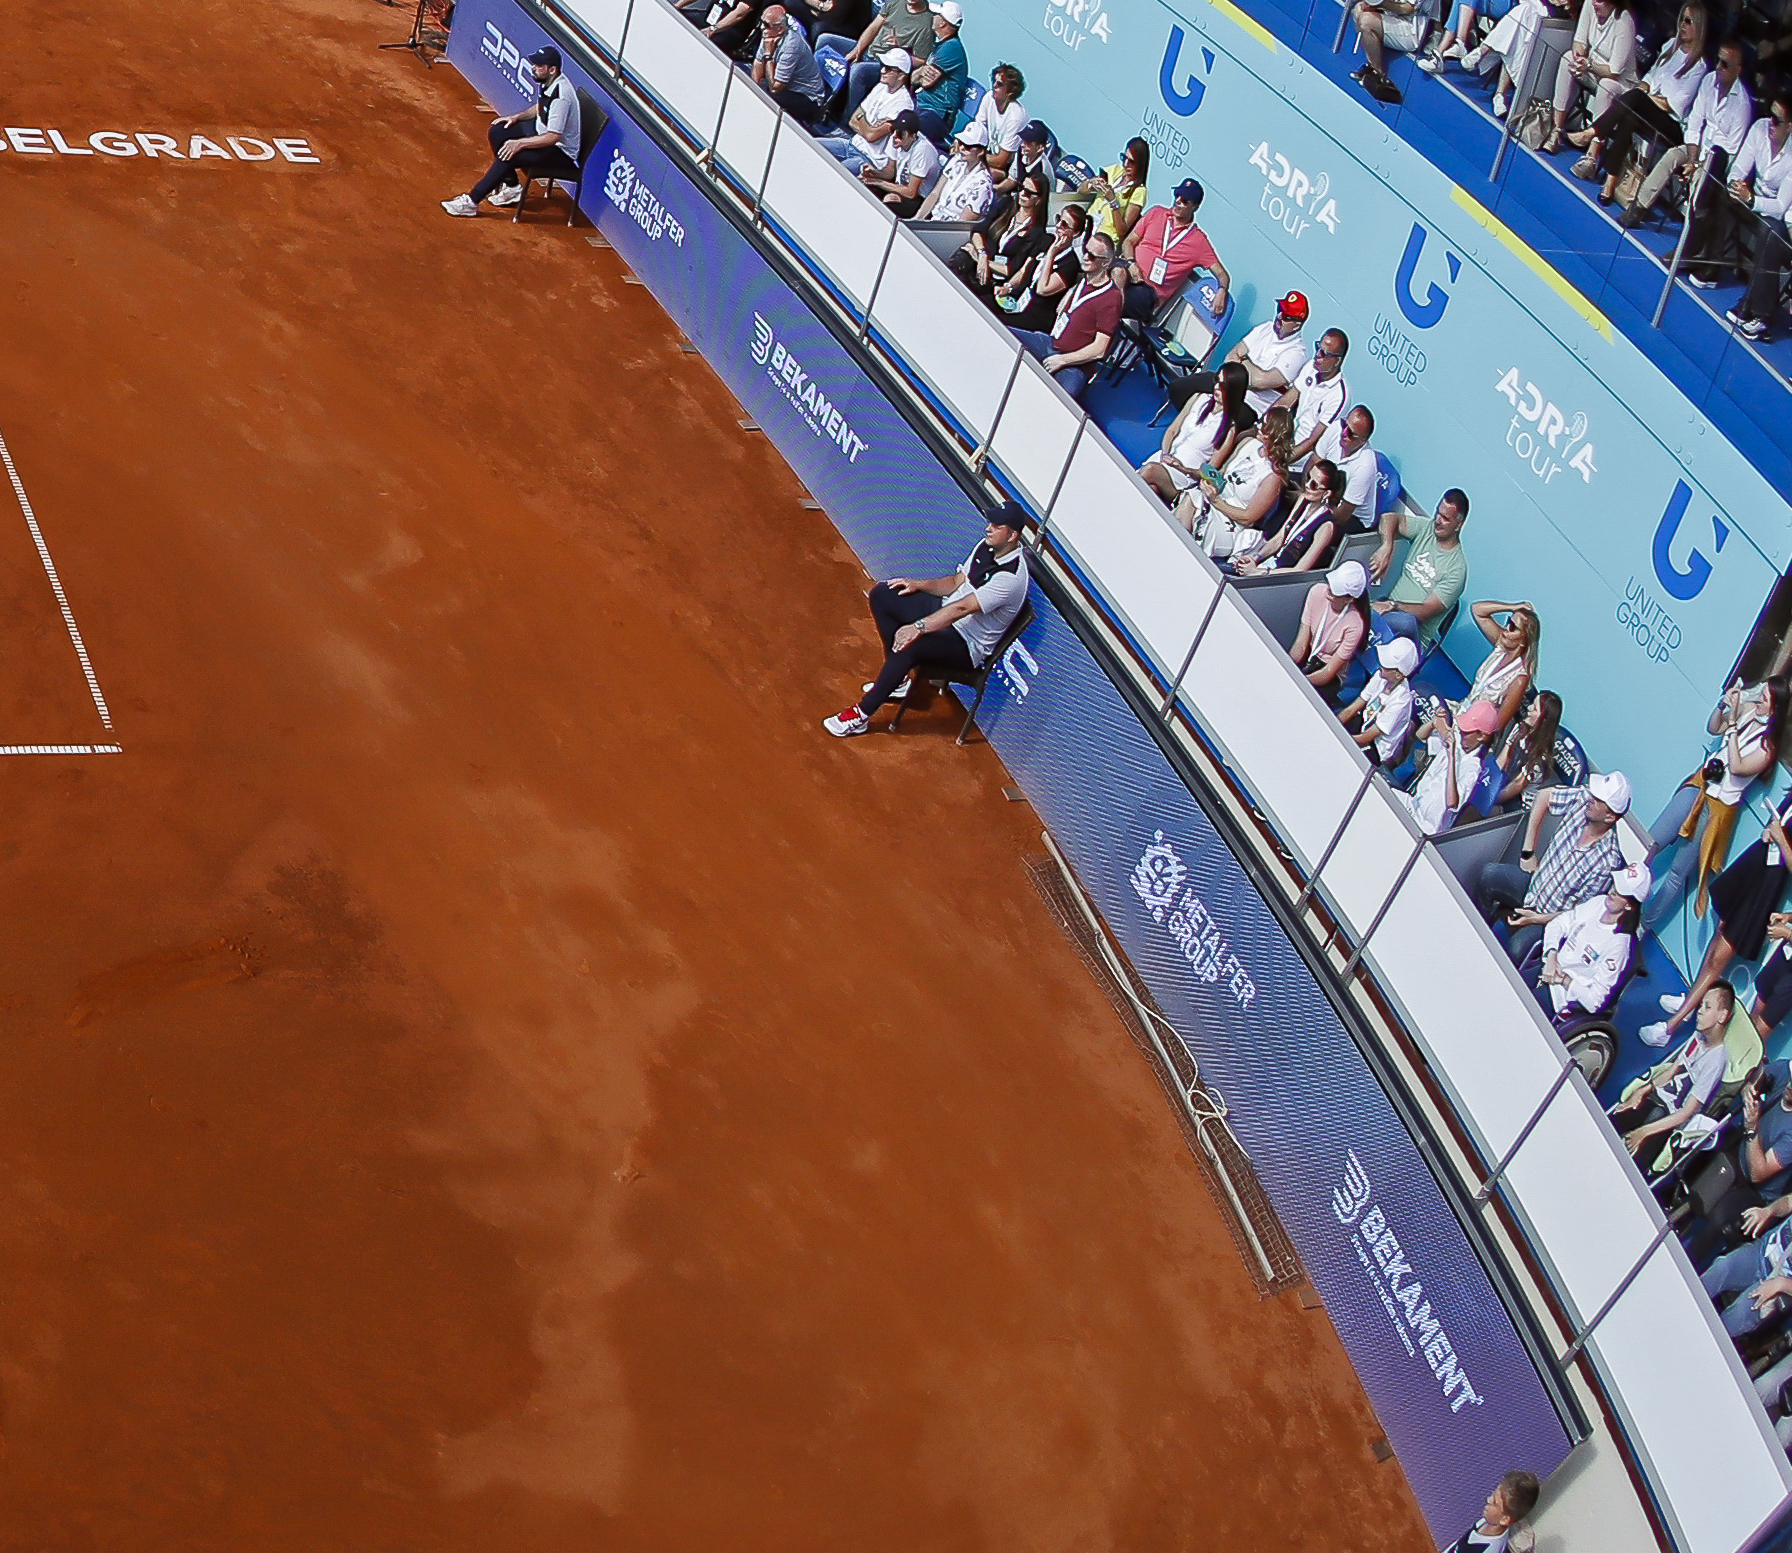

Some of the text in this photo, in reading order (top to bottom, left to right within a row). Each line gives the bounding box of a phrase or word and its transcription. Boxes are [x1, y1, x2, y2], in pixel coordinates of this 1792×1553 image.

[1043, 1, 1088, 52] tour
[1138, 126, 1183, 172] GROUP
[1142, 104, 1191, 157] UNITED
[628, 199, 663, 241] GROUP
[632, 178, 687, 248] METALFER
[1247, 140, 1342, 236] ADRIA
[1259, 182, 1311, 240] tour
[1366, 333, 1419, 390] GROUP
[1372, 311, 1428, 375] UNITED
[770, 340, 869, 464] BEKAMENT
[1493, 366, 1599, 485] ADRIA
[1504, 413, 1563, 485] tour
[1615, 601, 1670, 666] GROUP
[1624, 575, 1684, 651] UNITED
[1166, 911, 1220, 984] GROUP
[1178, 888, 1258, 1011] METALFER
[1359, 1204, 1484, 1414] BEKAMENT
